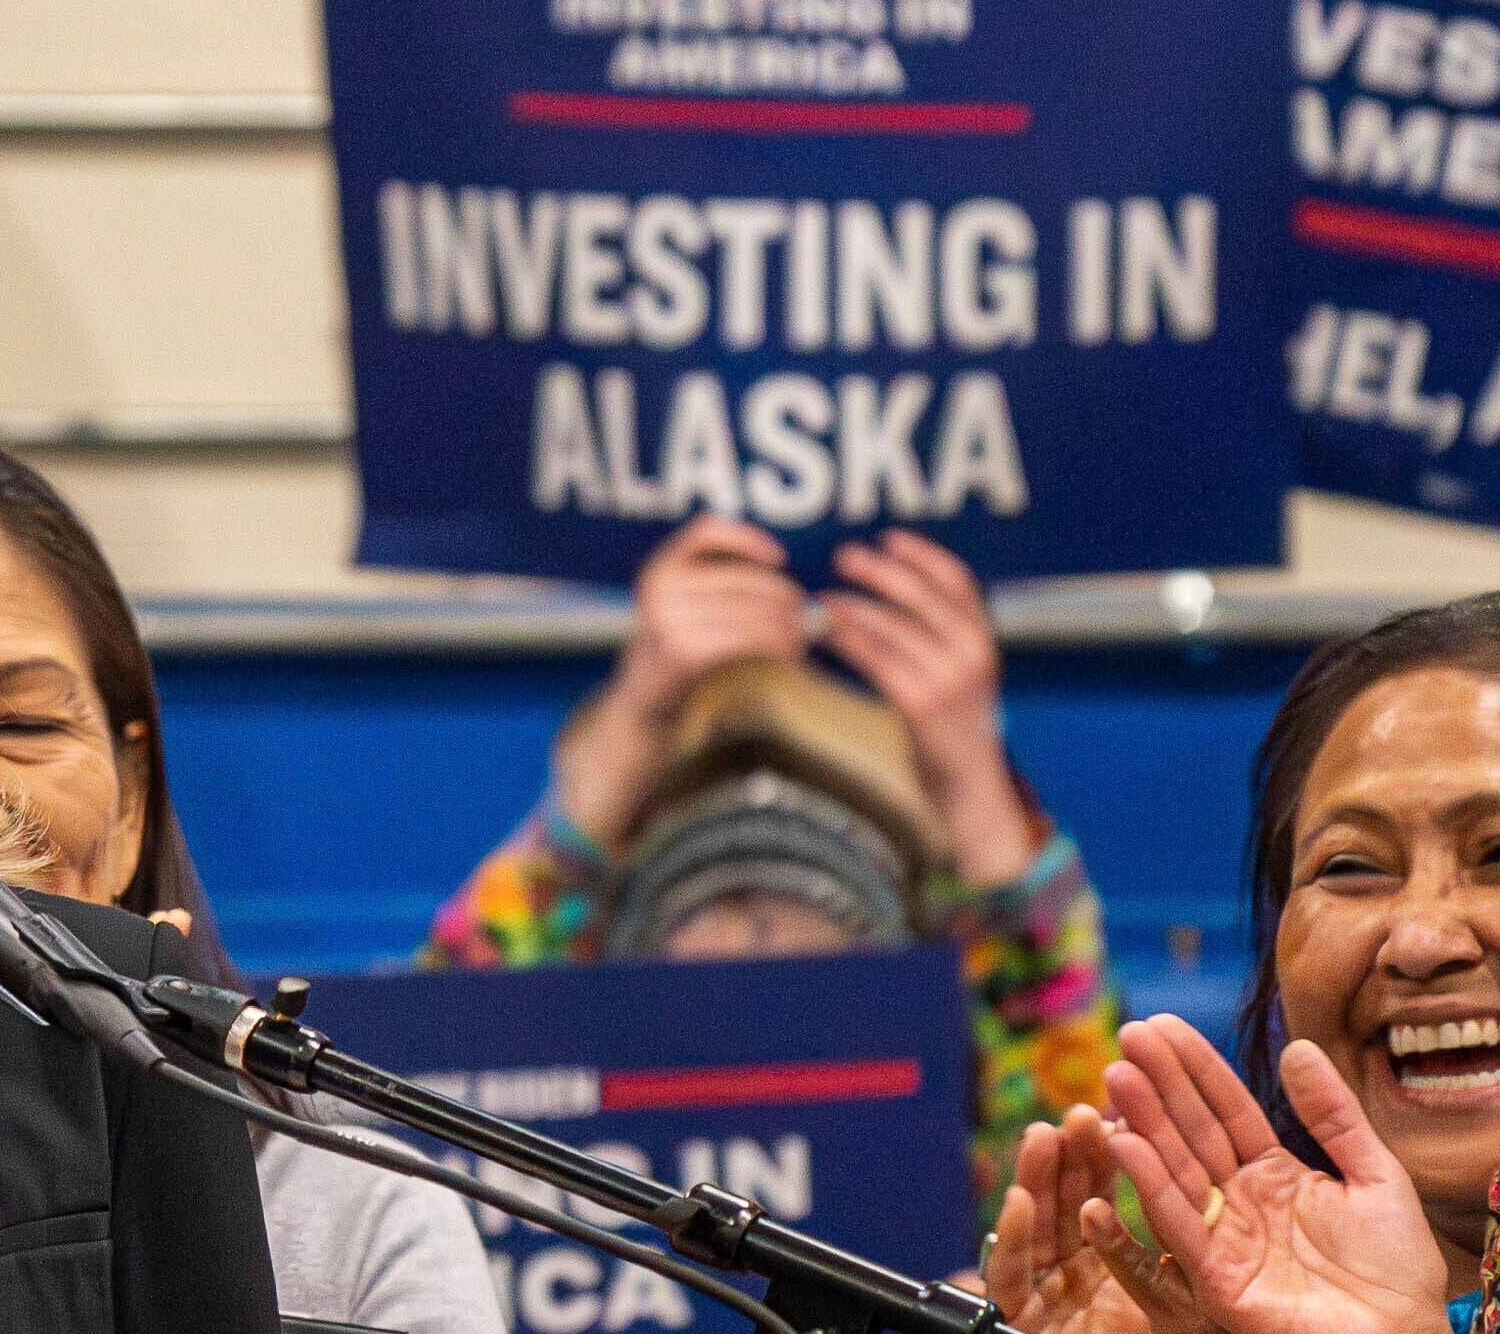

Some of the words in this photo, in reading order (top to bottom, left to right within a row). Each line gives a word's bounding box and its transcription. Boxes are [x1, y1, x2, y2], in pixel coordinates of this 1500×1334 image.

[380, 183, 1037, 351] INVESTING
[1067, 195, 1217, 345] IN
[530, 359, 1035, 529] ALASKA
